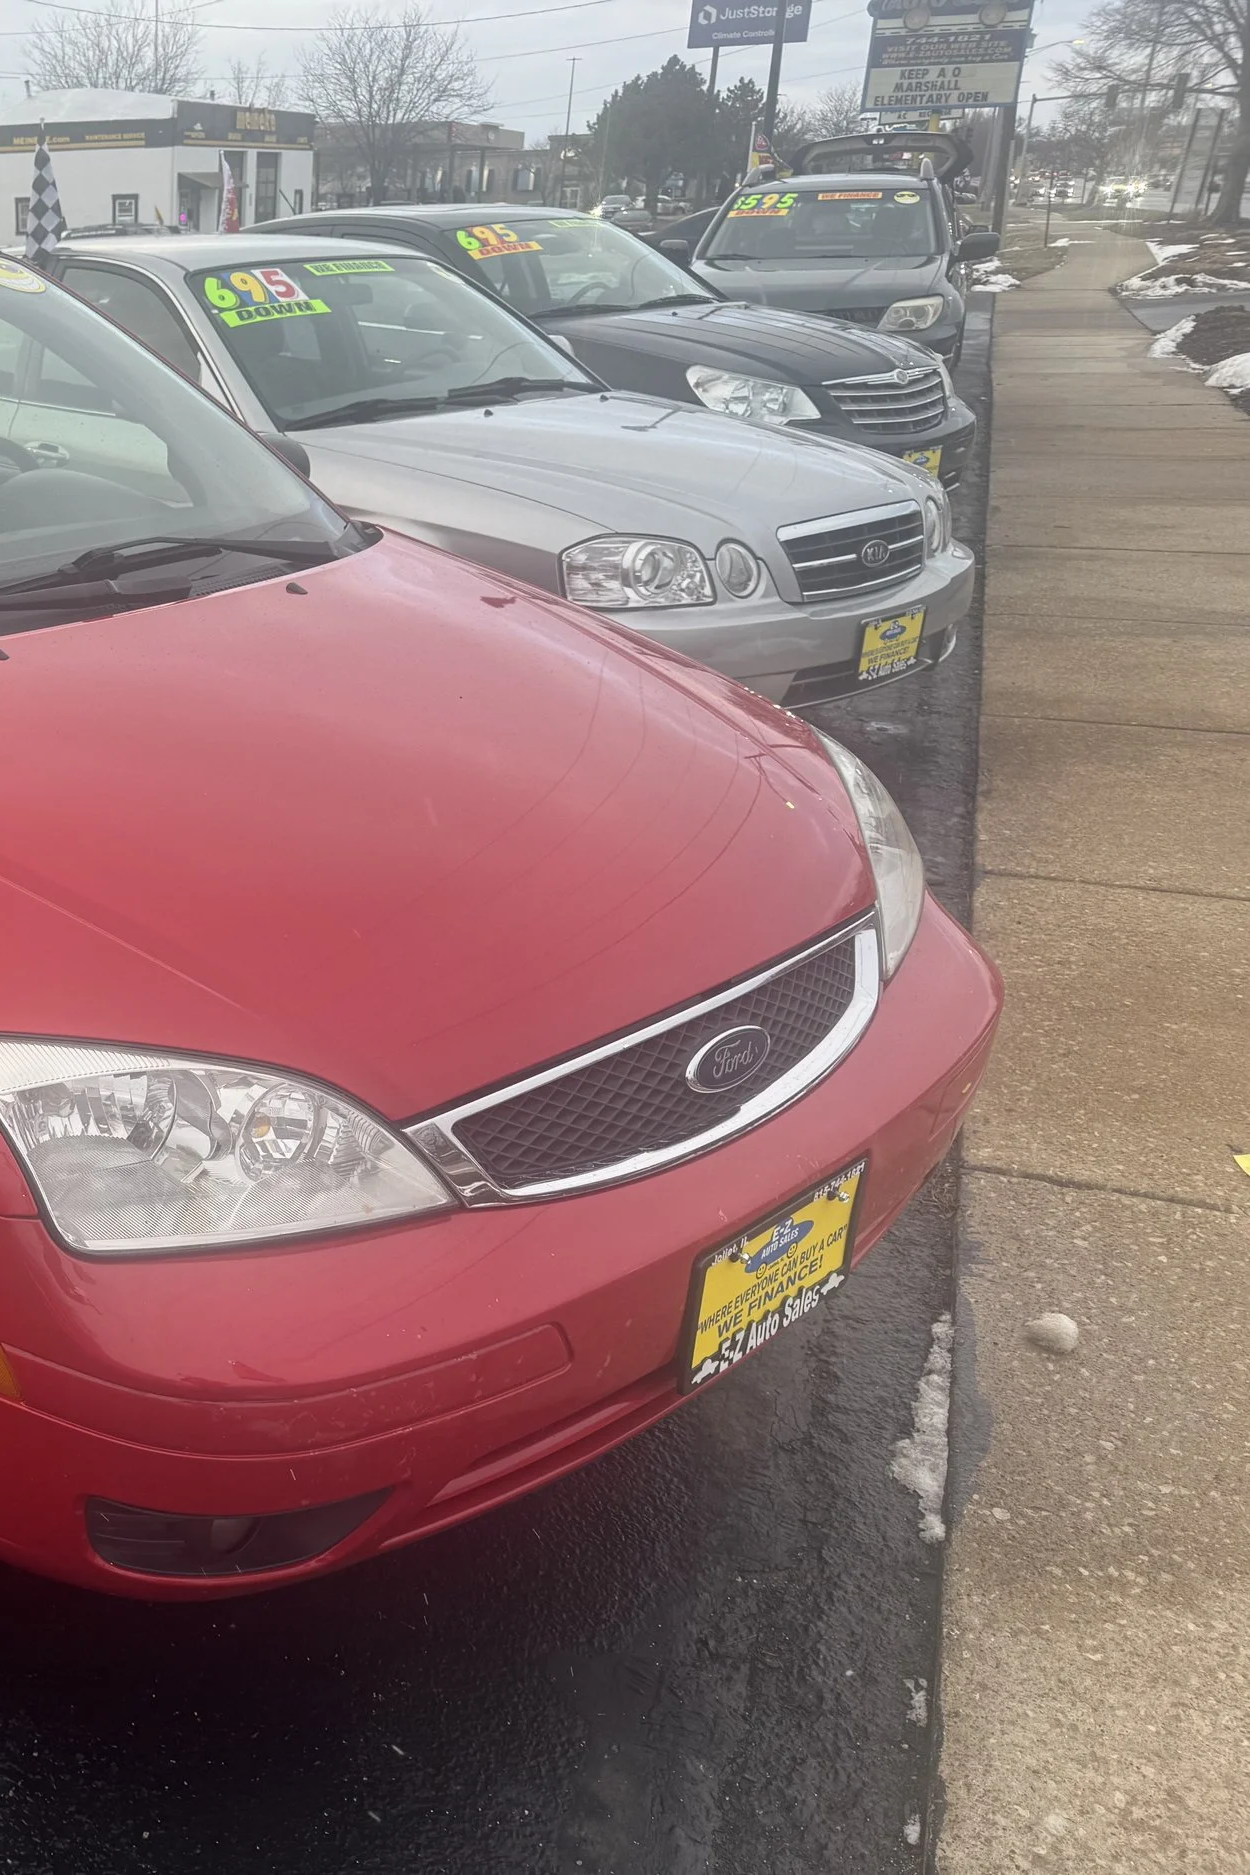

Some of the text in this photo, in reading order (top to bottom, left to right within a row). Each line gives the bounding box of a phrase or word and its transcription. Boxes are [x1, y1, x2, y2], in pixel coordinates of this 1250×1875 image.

[720, 3, 803, 20] JustStorge
[712, 31, 741, 40] Climate
[887, 45, 919, 53] VISIT
[920, 43, 948, 51] OUR
[900, 68, 929, 80] KEEP
[936, 67, 946, 78] A
[873, 91, 989, 107] ELEMENTARY OPEN
[456, 224, 518, 250] 695
[478, 243, 534, 256] DOWN
[312, 261, 386, 273] WE FINANCE
[204, 269, 299, 309] 695
[236, 302, 317, 322] DOWN
[866, 545, 886, 561] KIA
[713, 1040, 754, 1078] Ford
[772, 1218, 793, 1242] E-Z
[740, 1236, 750, 1250] IL
[761, 1228, 799, 1259] AUTO SALES
[734, 1271, 779, 1309] EVERYONE
[781, 1256, 797, 1277] CAN
[800, 1242, 818, 1265] BUY
[818, 1239, 824, 1253] A
[717, 1254, 823, 1338] WE FINANCE!
[747, 1313, 779, 1355] Auto
[782, 1286, 820, 1328] Sales
